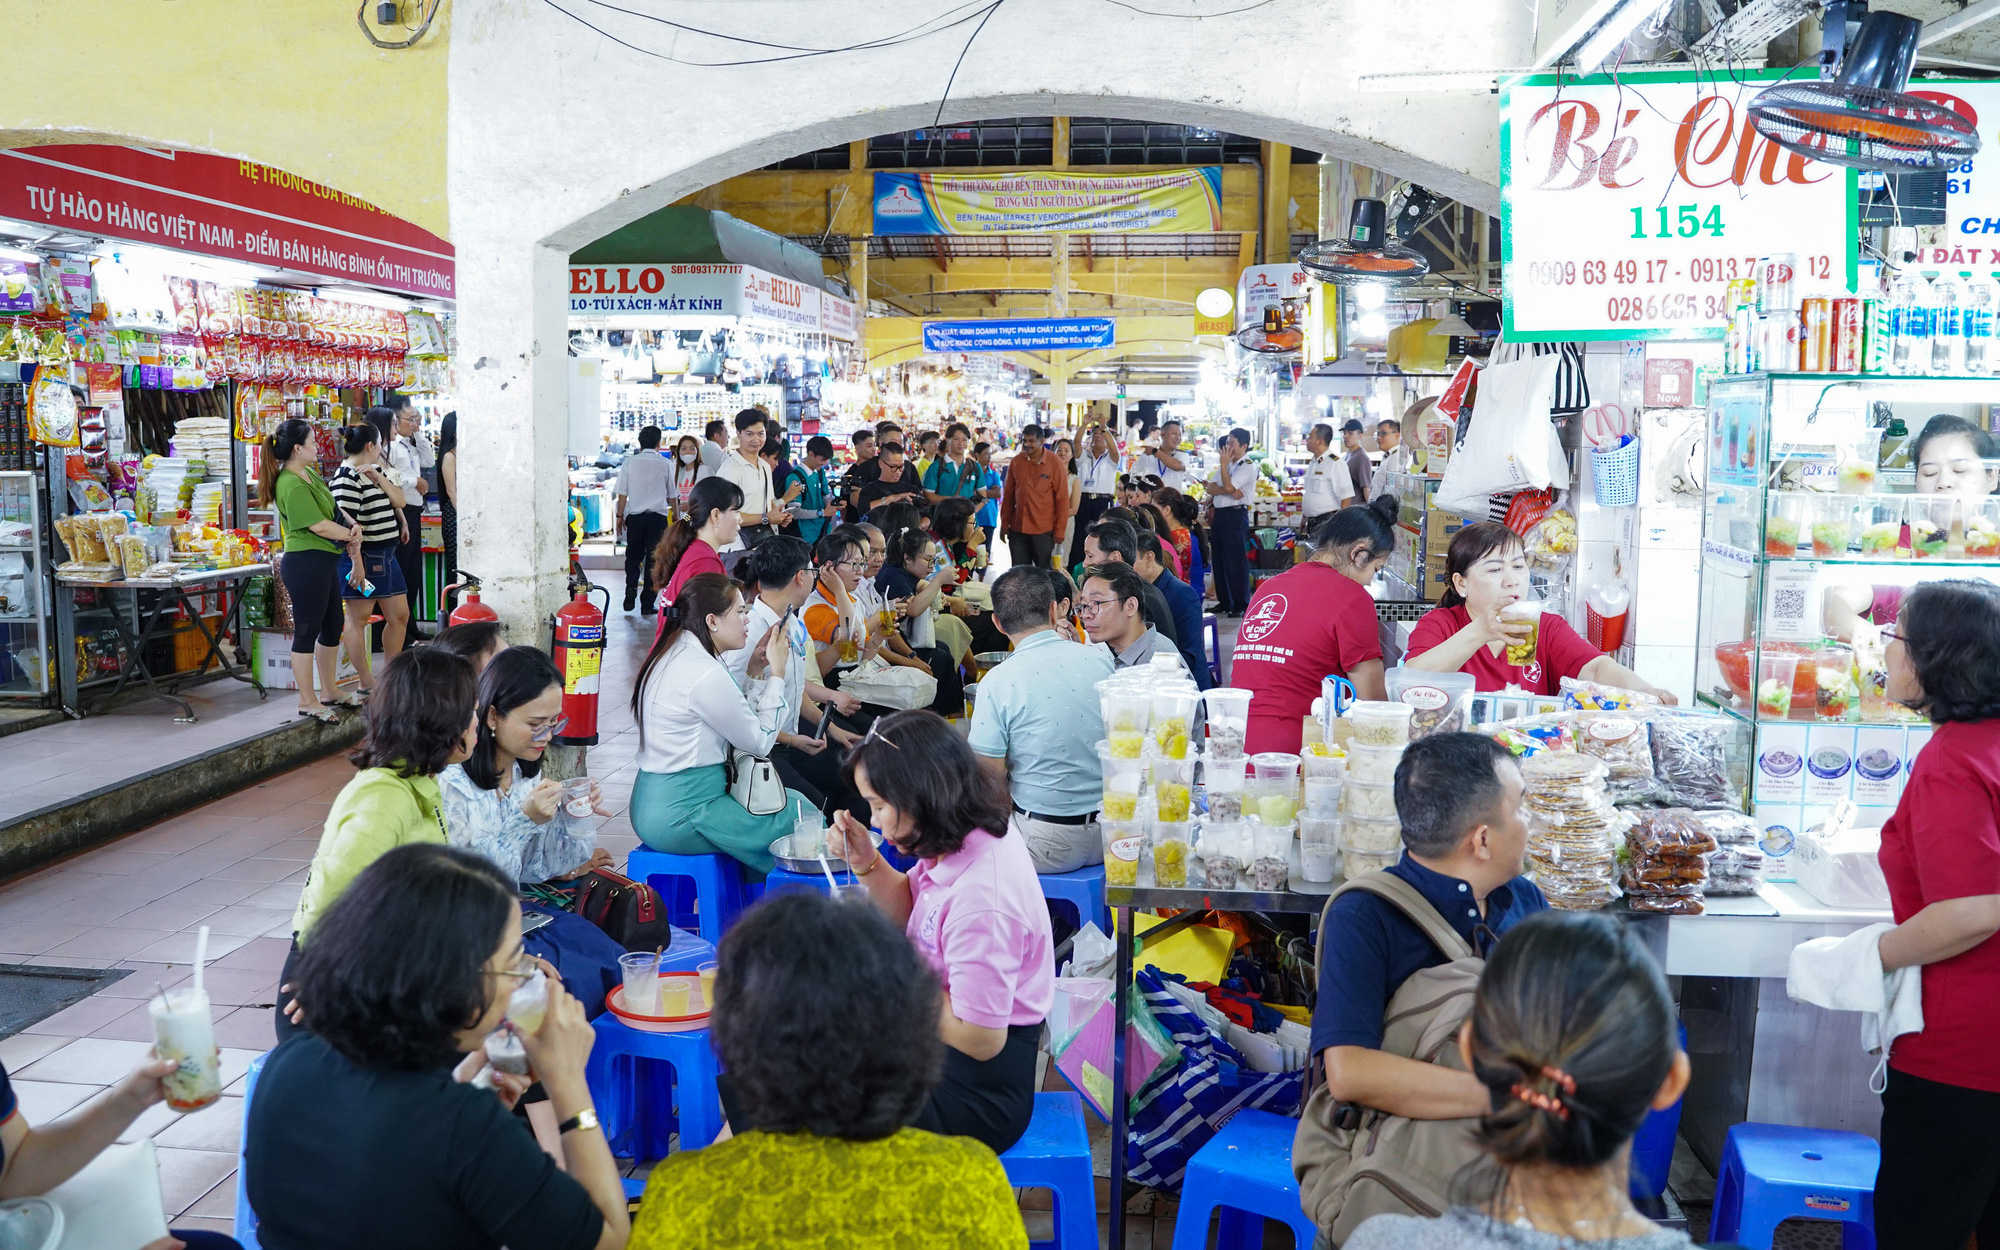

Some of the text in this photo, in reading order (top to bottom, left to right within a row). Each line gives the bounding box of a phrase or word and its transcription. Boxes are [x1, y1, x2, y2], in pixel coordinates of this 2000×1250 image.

[1522, 100, 1644, 190] Bé
[963, 180, 995, 192] THƯƠNG
[996, 179, 1014, 194] CHỢ
[1015, 175, 1030, 191] BẾN
[1032, 176, 1059, 190] THÀNH
[1061, 177, 1077, 190] XÂY
[994, 197, 1020, 207] TRONG
[1040, 192, 1065, 207] NGƯỜI
[1067, 193, 1084, 206] DÂN
[1086, 191, 1096, 206] VÀ
[1098, 195, 1110, 205] DU
[1111, 192, 1140, 205] KHÁCH
[956, 214, 972, 222] BEN
[975, 213, 1001, 221] THANH
[1004, 213, 1036, 221] MARKET
[1038, 213, 1076, 221] VENDORS
[1078, 212, 1101, 220] BUILD
[1110, 210, 1151, 218] FRIENDLY
[1152, 209, 1177, 218] IMAGE
[1630, 204, 1725, 238] 1154
[1045, 221, 1090, 230] RESIDENTS
[1092, 220, 1109, 228] AND
[1111, 220, 1150, 228] TOURISTS
[26, 185, 56, 219] TỰ
[60, 191, 103, 222] HÀO
[106, 201, 158, 234] HÀNG
[160, 214, 197, 245] VIỆT
[199, 222, 235, 249] NAM
[245, 229, 280, 258] ĐIỂM
[283, 239, 309, 263] BÁN
[312, 245, 347, 271] HÀNG
[349, 252, 375, 277] BÌNH
[377, 255, 393, 279] ỔN
[394, 264, 411, 287] THỊ
[412, 267, 451, 291] TRƯỜNG
[1529, 261, 1576, 285] 0909
[1583, 260, 1607, 285] 63
[1613, 259, 1637, 284] 49
[1646, 259, 1668, 283] 17
[1690, 258, 1738, 282] 0913
[569, 268, 665, 294] ELLO
[771, 277, 801, 308] HELLO
[572, 299, 587, 310] LO
[688, 296, 723, 310] KÍNH
[999, 327, 1017, 335] THỰC
[974, 338, 992, 347] CỘNG
[1022, 338, 1031, 347] SỰ
[1032, 336, 1049, 345] PHÁT
[1657, 394, 1681, 403] Now
